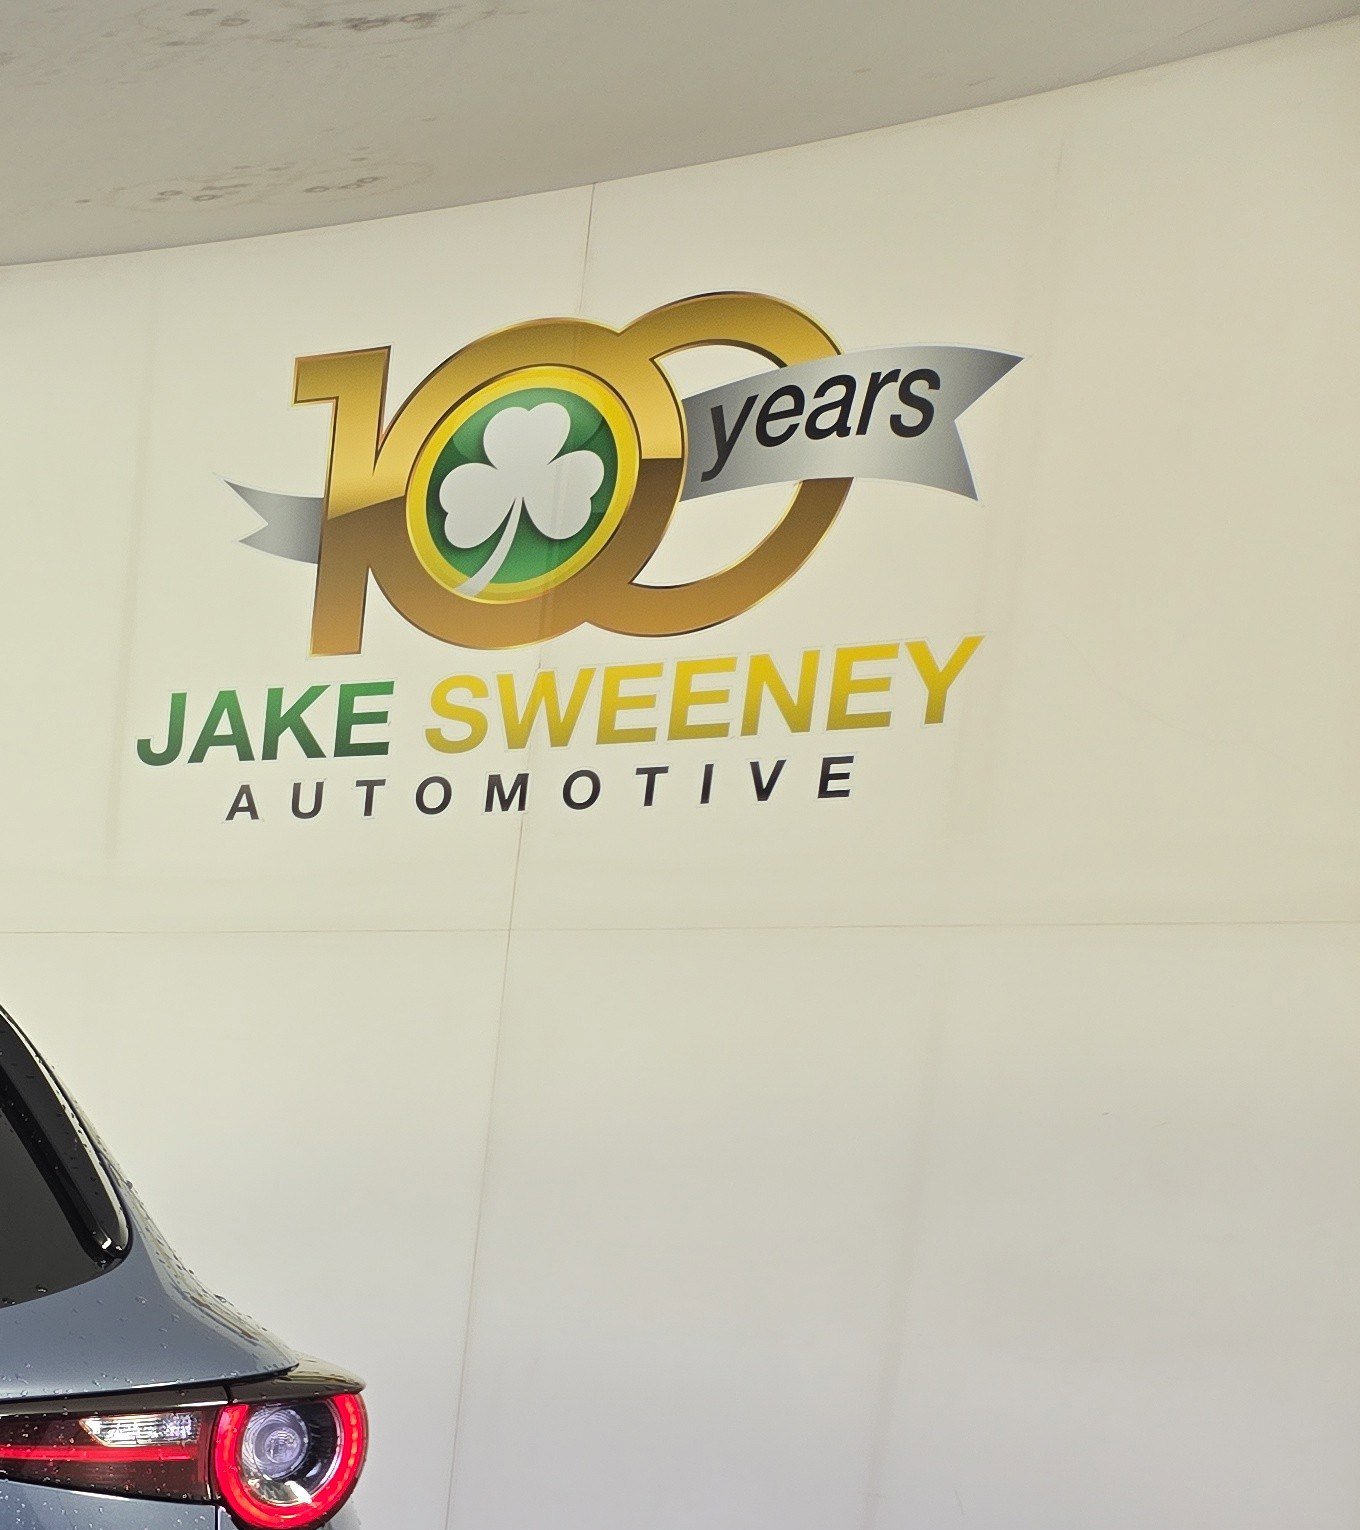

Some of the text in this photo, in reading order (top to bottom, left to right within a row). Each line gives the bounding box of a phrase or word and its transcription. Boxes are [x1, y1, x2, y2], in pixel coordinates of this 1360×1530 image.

[293, 290, 855, 658] 100
[701, 362, 941, 482] years
[136, 636, 985, 768] JAKE SWEENEY
[225, 755, 856, 823] AUTOMOTIVE
